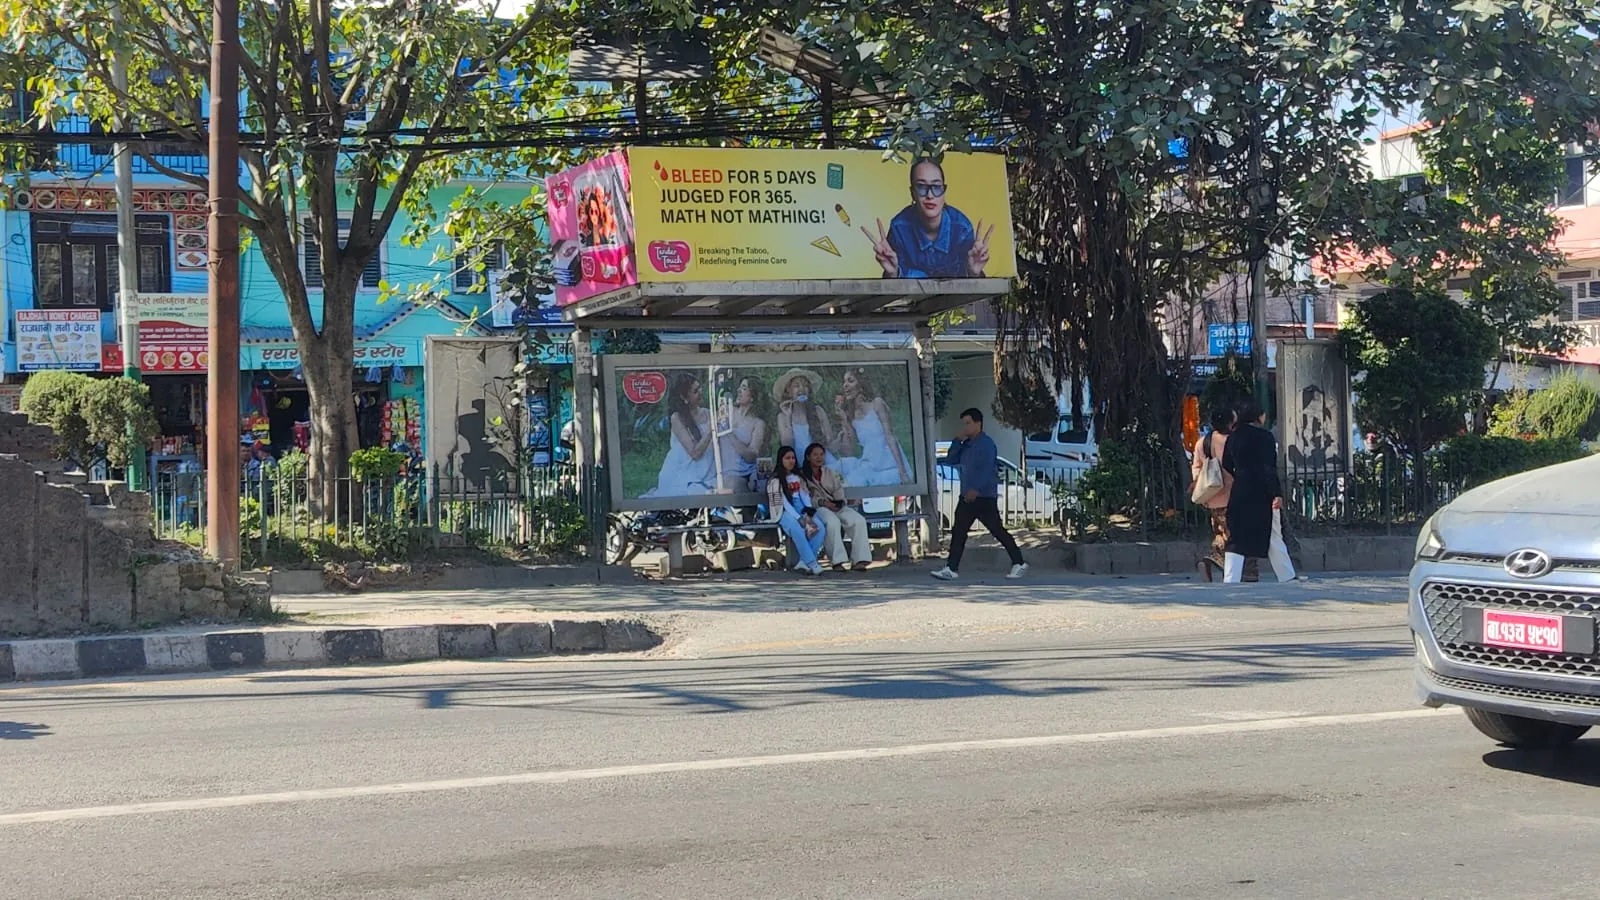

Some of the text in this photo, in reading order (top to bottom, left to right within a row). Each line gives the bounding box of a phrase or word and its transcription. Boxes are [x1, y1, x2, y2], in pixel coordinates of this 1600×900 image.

[672, 169, 817, 185] BLEED FOR 5 DAYS
[660, 189, 797, 204] JUDGED FOR 365.
[661, 209, 826, 224] MATH NOT MATHING!
[654, 246, 677, 260] Tender
[698, 247, 769, 256] Breaking The Taboo,
[662, 254, 683, 269] Touch
[699, 257, 787, 266] Redefining Feminine Care
[49, 311, 69, 320] MONEY
[69, 311, 97, 320] CHANGER
[370, 343, 406, 358] स्टोर
[636, 386, 657, 399] Touch
